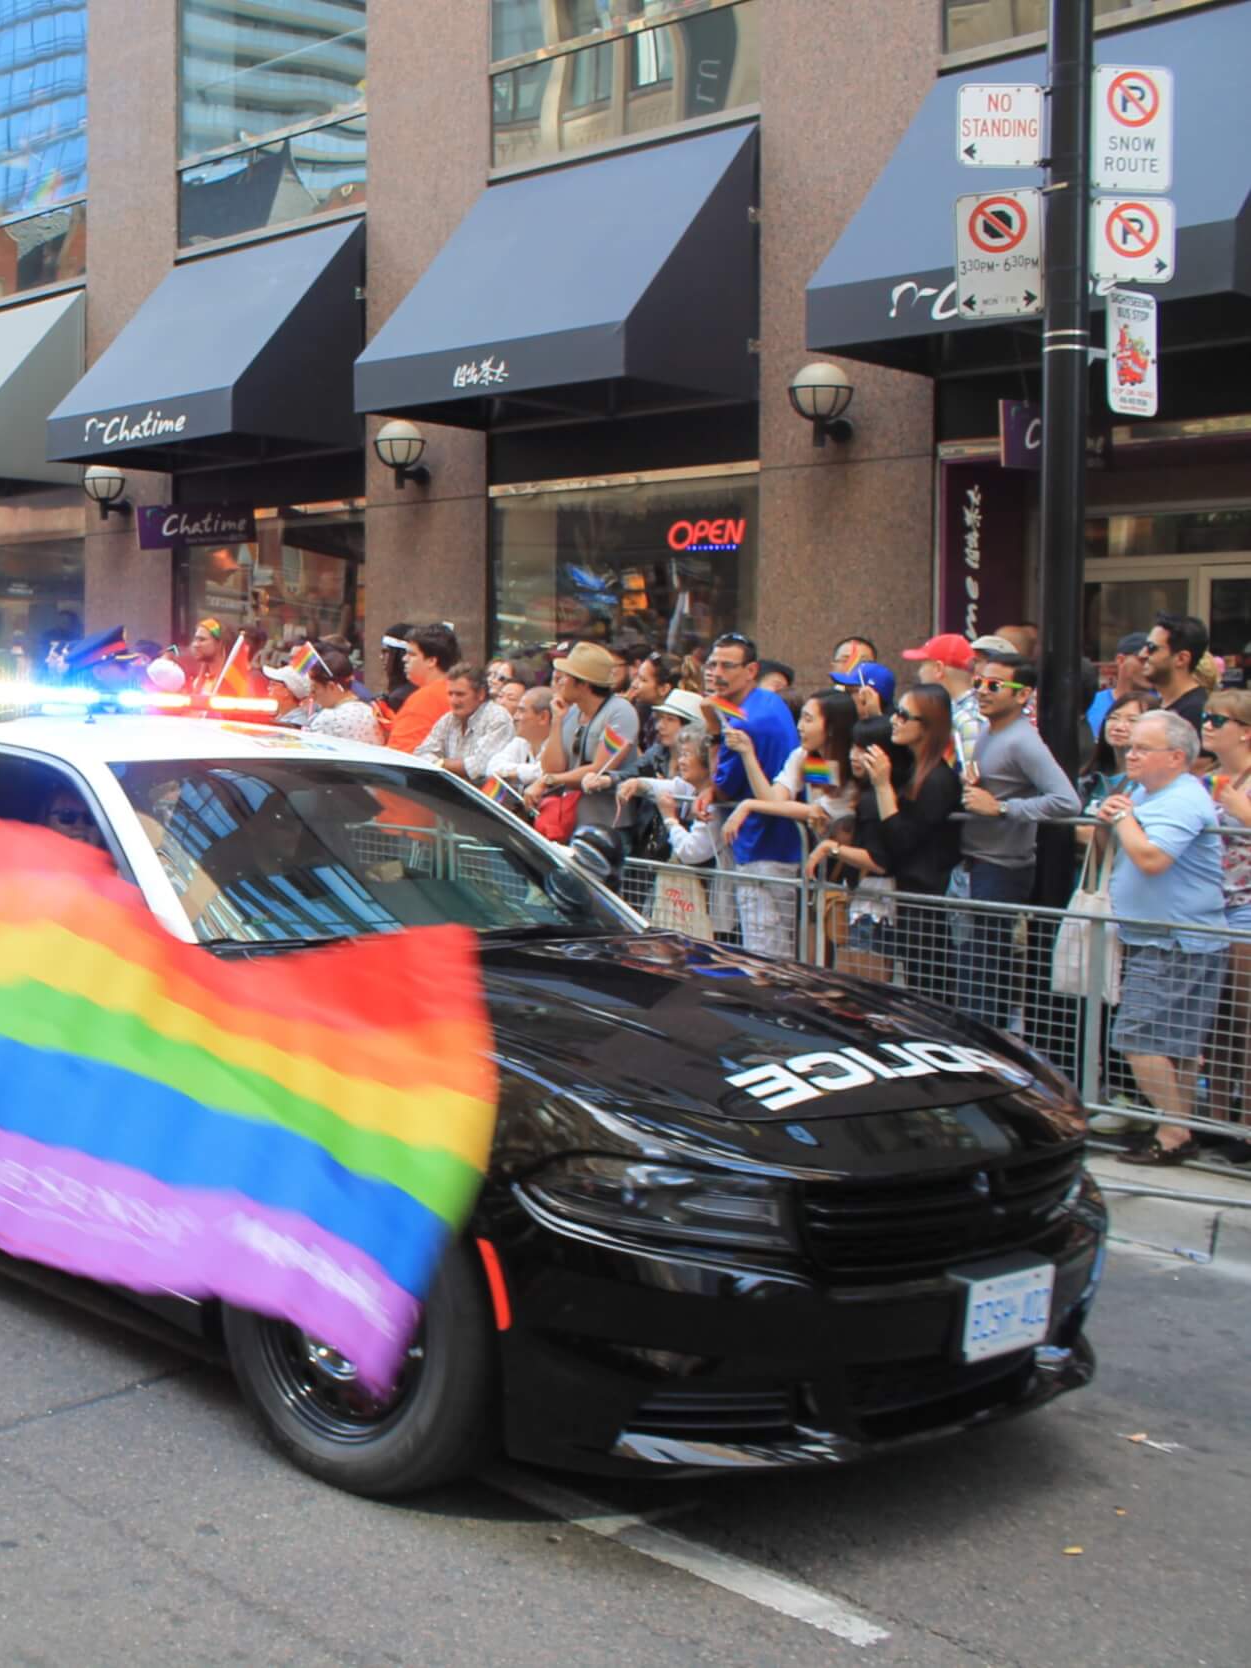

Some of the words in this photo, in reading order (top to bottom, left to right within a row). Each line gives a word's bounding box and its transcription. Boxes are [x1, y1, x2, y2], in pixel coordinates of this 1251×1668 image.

[987, 93, 1012, 113] NO
[962, 118, 1038, 138] STANDING
[1108, 136, 1155, 152] SNOW
[1104, 156, 1159, 174] ROUTE
[102, 410, 186, 445] Chatime
[162, 512, 247, 537] Chatime
[667, 518, 747, 551] OPEN
